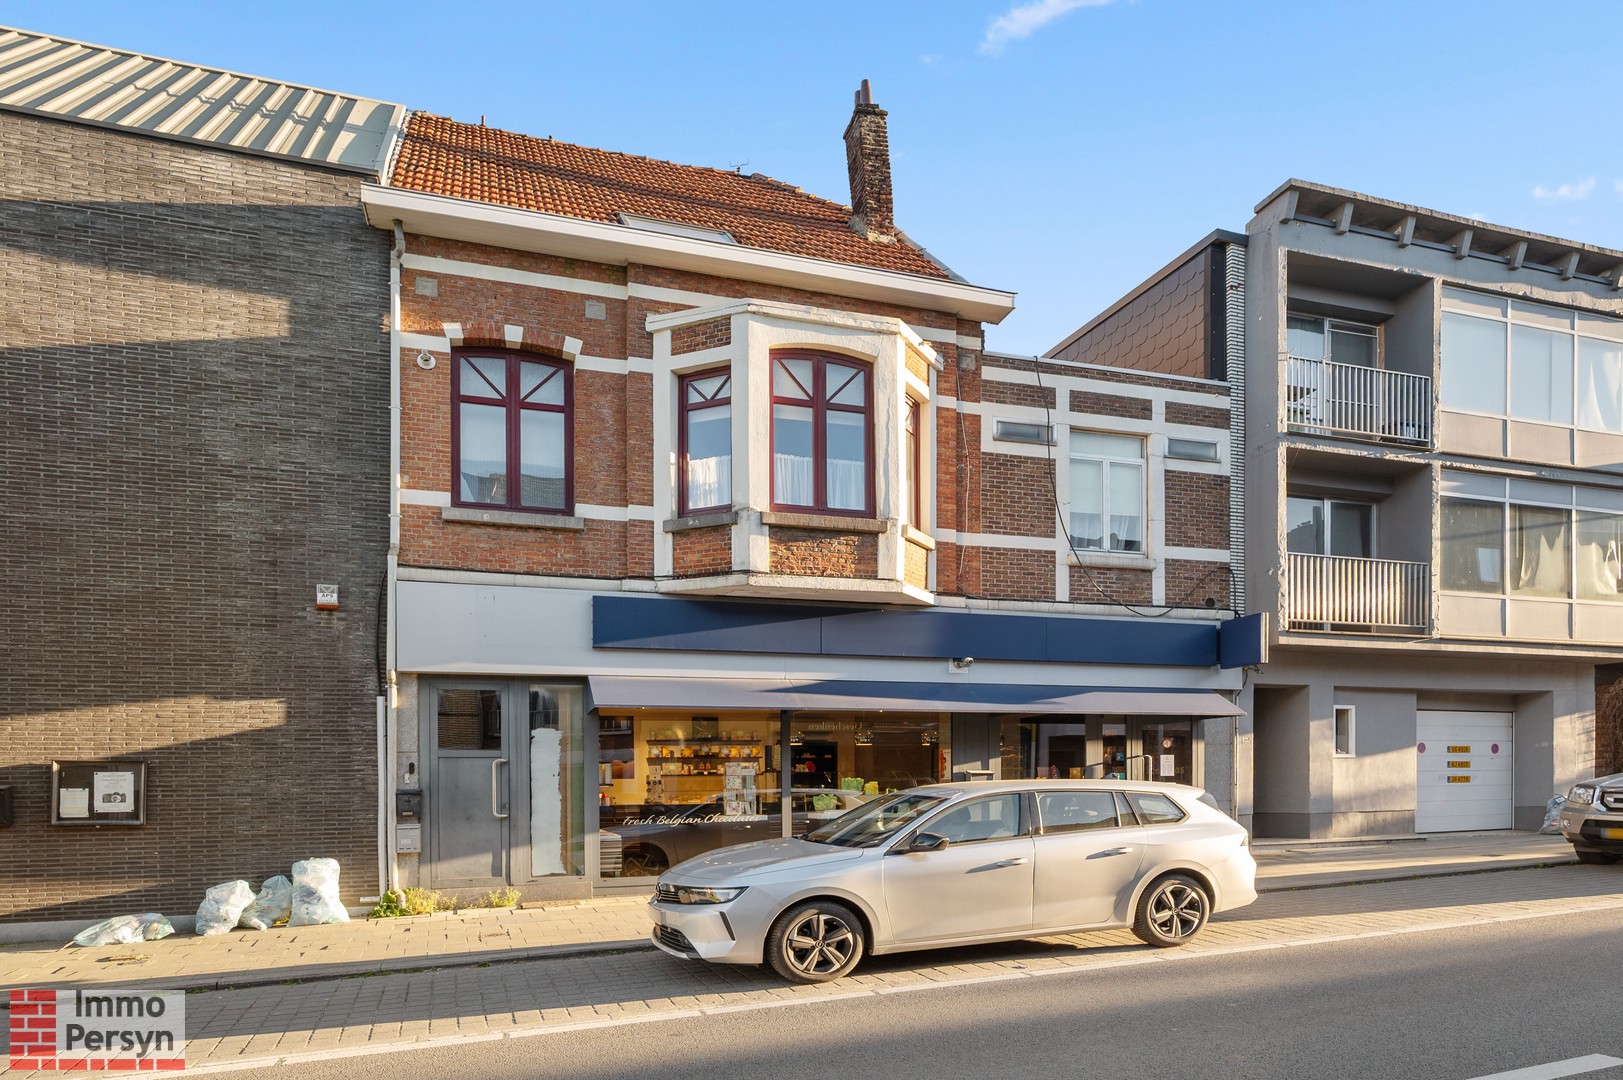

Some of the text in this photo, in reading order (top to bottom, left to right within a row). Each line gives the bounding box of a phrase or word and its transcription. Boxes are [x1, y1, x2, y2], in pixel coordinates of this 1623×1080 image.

[623, 812, 760, 828] Fresh Belgian Chocolates
